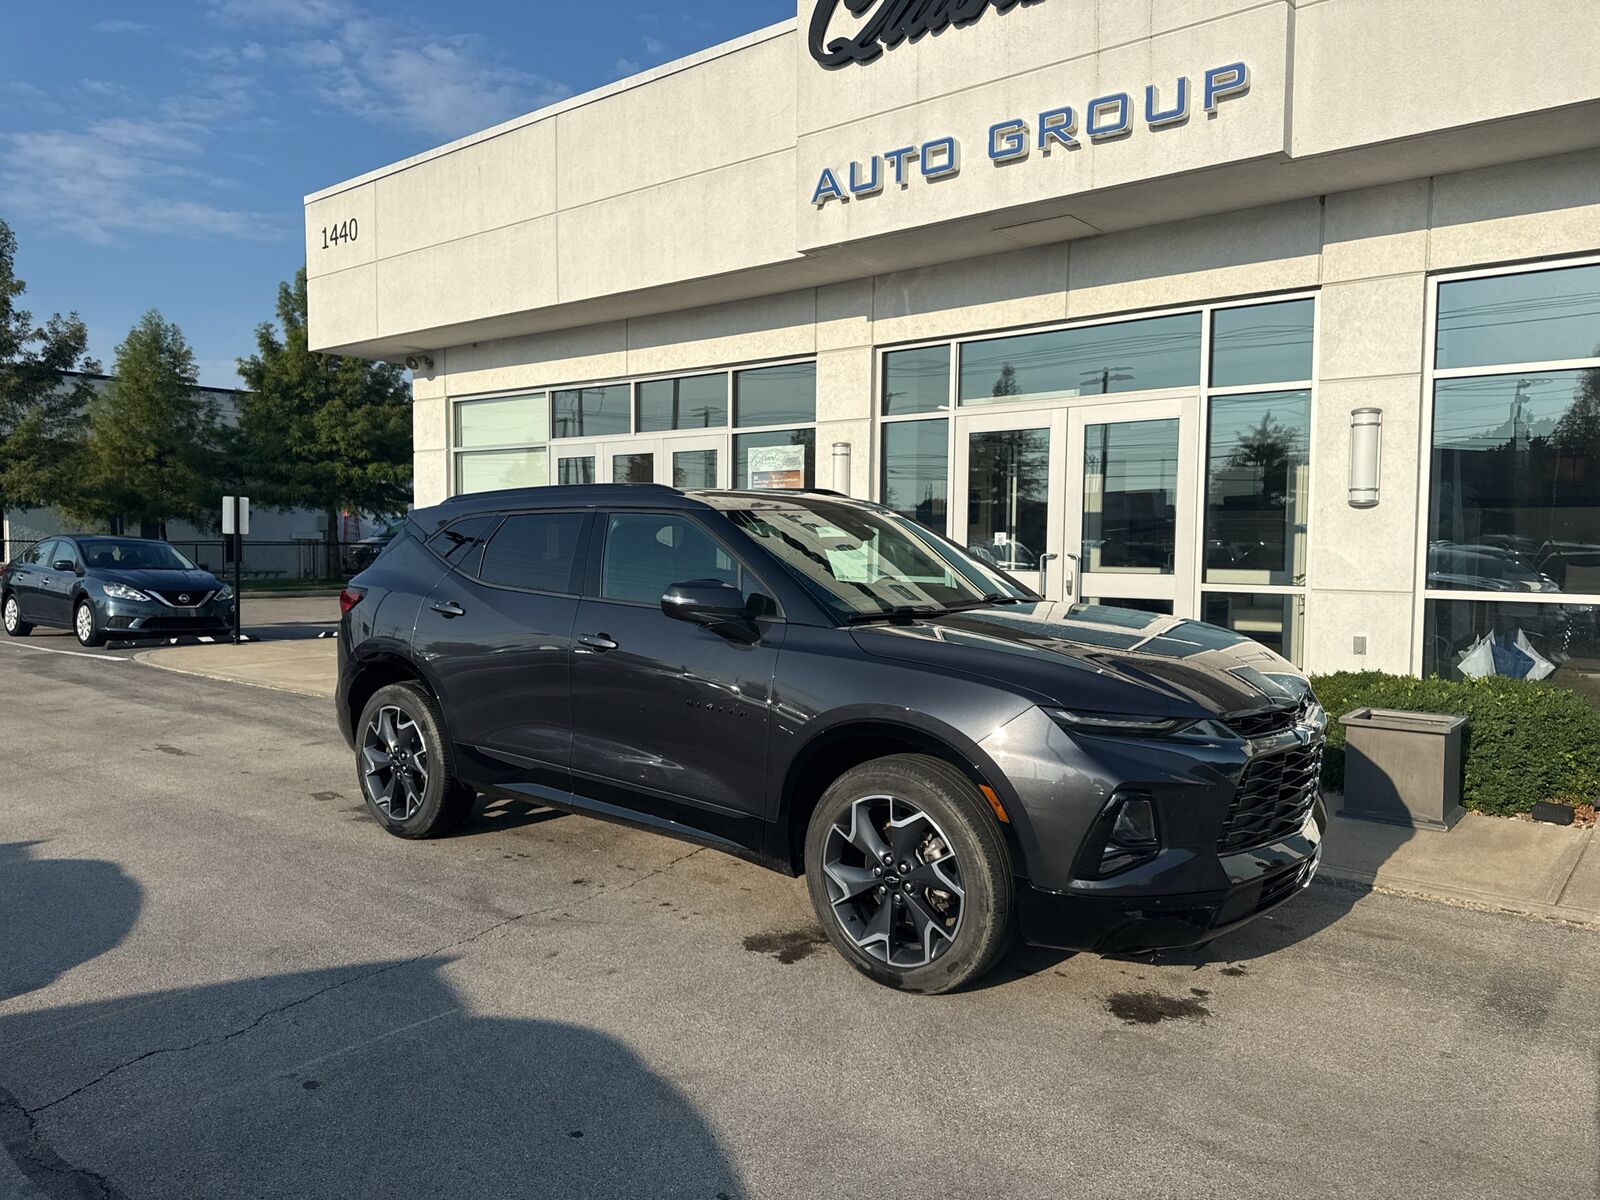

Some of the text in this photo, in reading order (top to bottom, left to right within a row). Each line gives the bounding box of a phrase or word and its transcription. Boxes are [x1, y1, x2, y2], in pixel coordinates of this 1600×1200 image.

[812, 61, 1250, 207] AUTO GROUP
[321, 217, 358, 250] 1440
